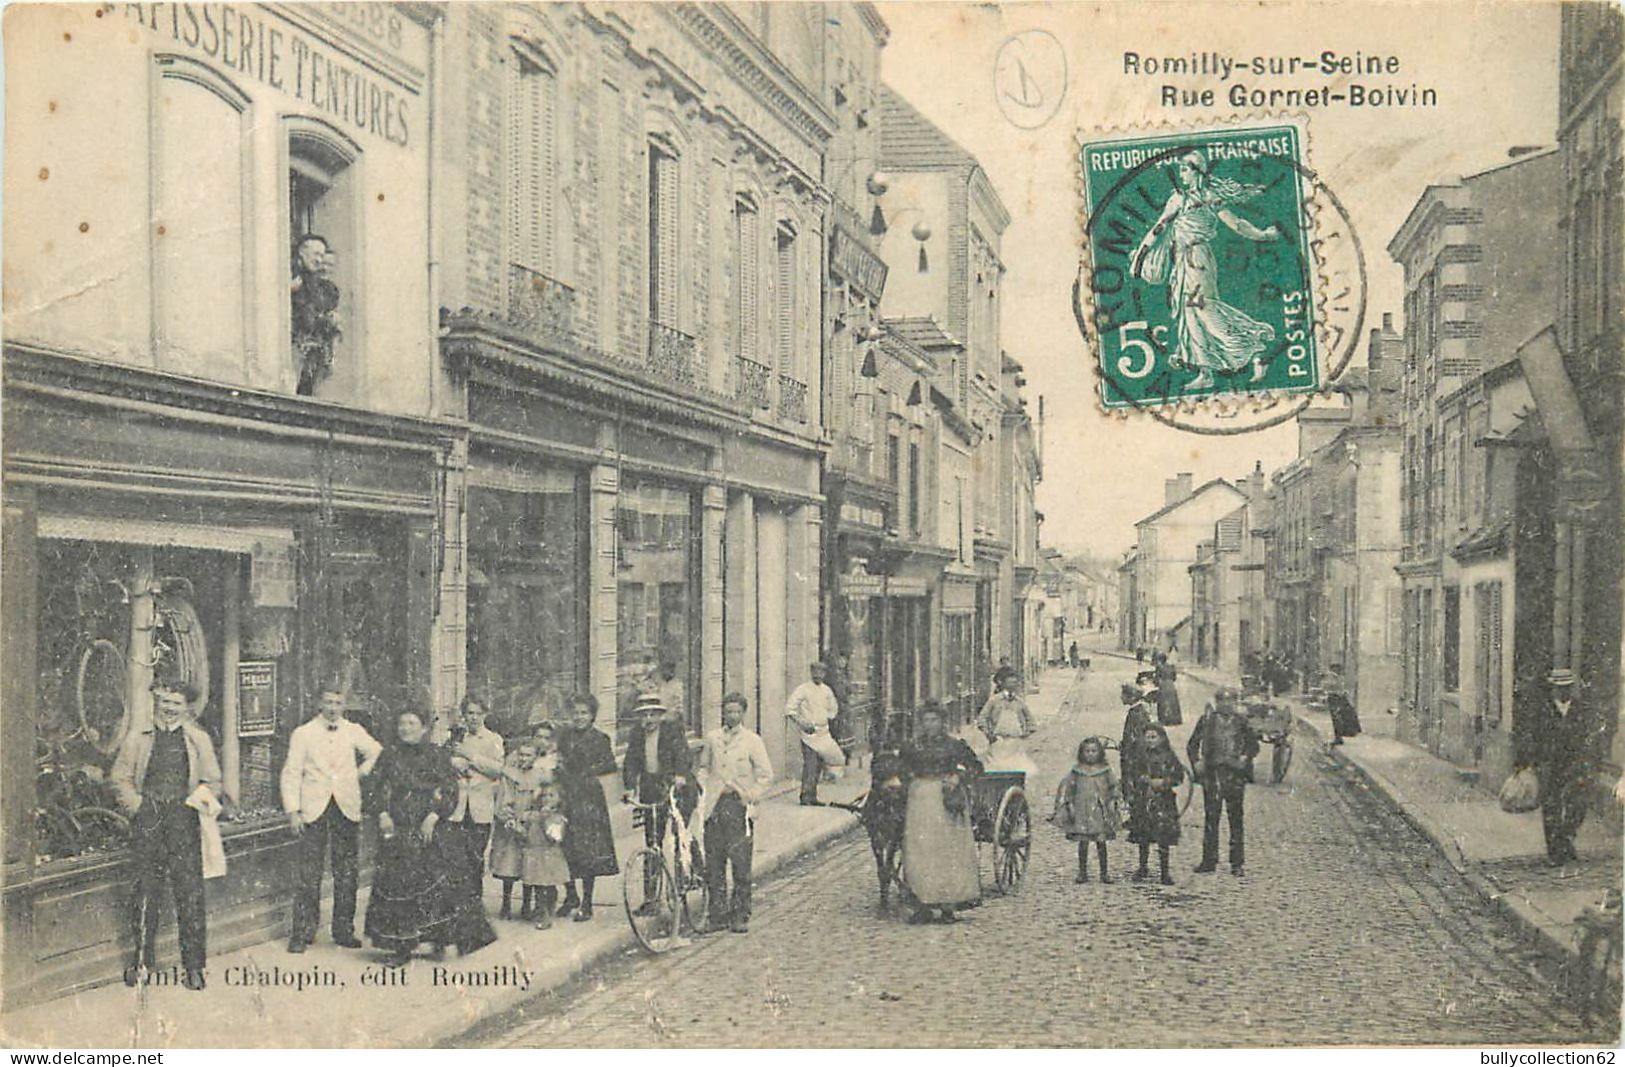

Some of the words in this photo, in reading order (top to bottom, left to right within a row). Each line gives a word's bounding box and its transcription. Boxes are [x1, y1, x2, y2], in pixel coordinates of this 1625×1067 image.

[291, 37, 409, 147] TENTURES
[1206, 135, 1290, 162] FRANÇAISE
[1283, 289, 1308, 379] POSTES
